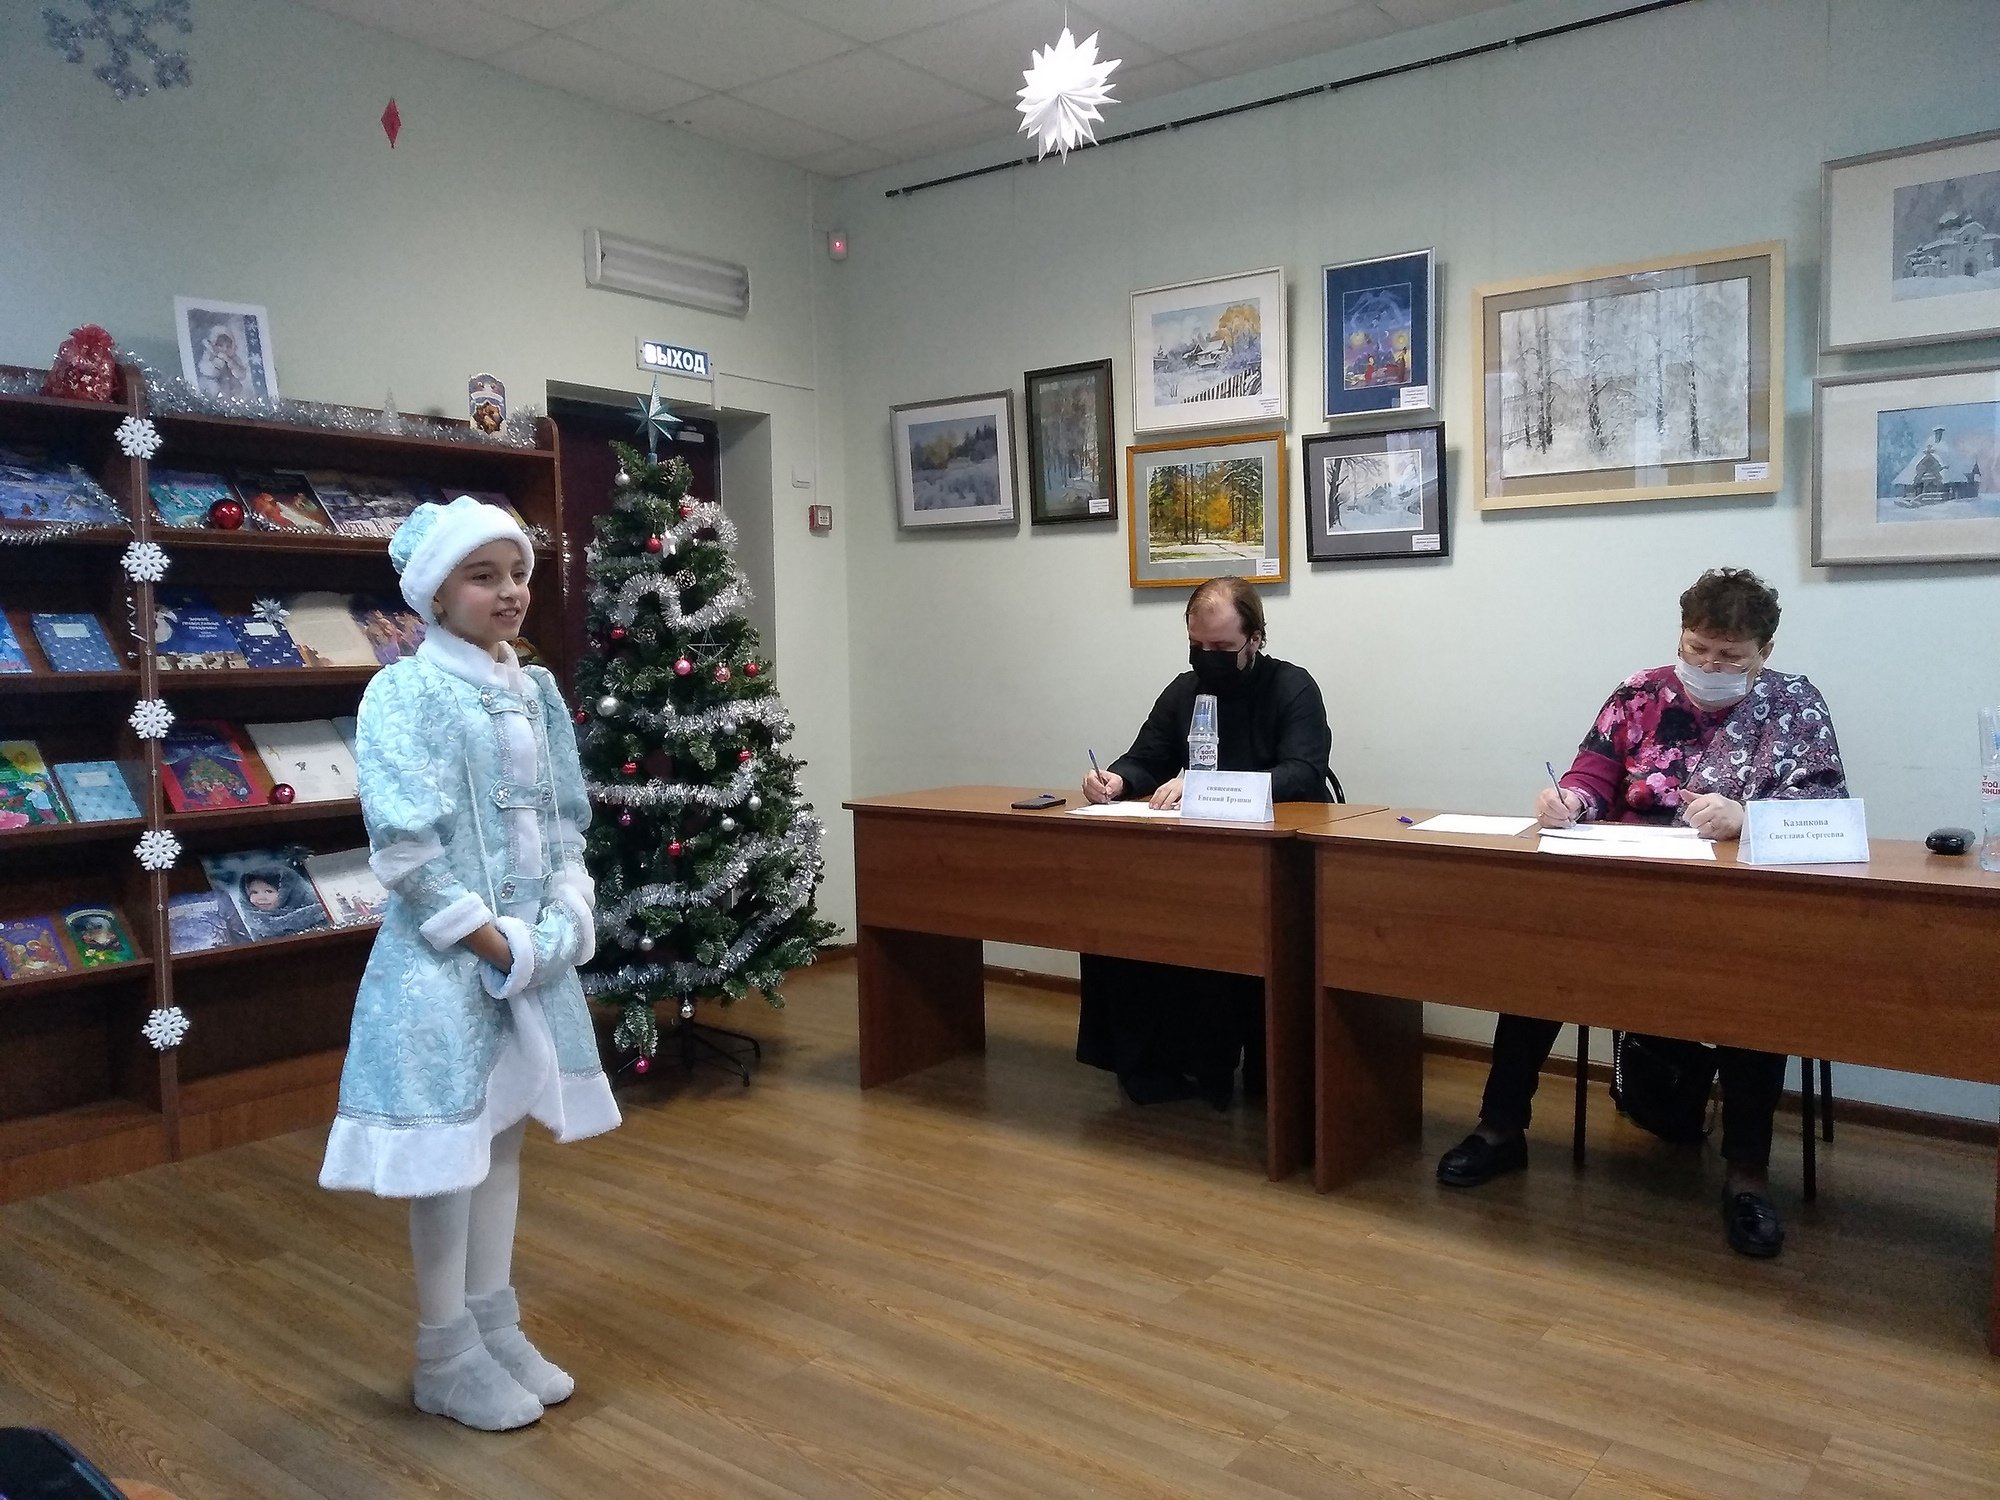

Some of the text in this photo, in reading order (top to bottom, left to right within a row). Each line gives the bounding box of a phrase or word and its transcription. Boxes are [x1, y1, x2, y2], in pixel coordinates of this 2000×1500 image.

[644, 343, 706, 375] ВЫХОД
[1198, 794, 1225, 802] Евгений
[1769, 831, 1844, 841] Светлана Сергеевна
